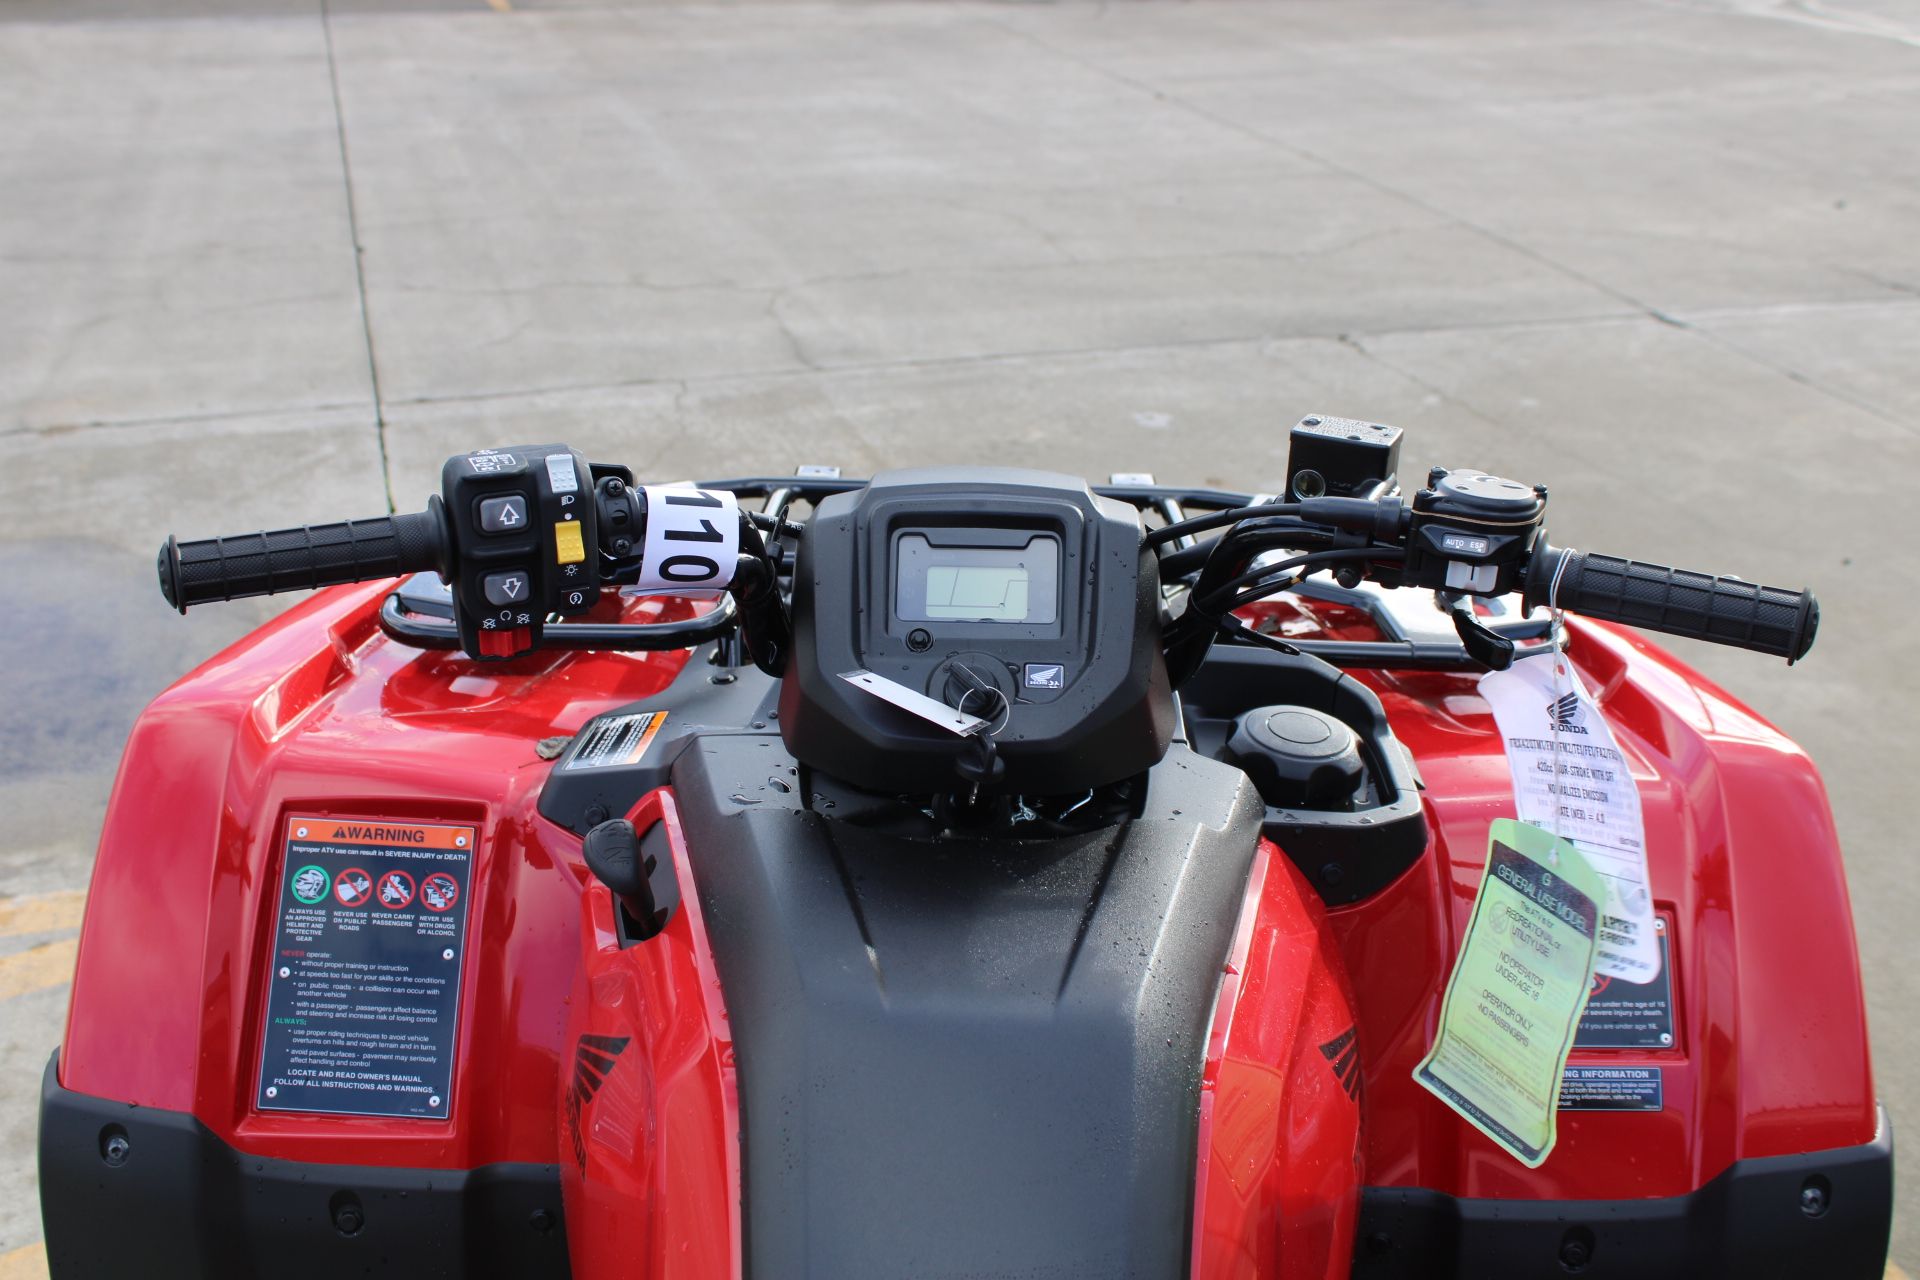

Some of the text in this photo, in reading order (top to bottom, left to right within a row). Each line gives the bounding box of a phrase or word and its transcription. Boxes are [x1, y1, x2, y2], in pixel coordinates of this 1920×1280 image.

[659, 491, 723, 582] 110
[348, 826, 424, 842] WARNING
[292, 845, 320, 854] Improper
[1542, 873, 1552, 886] G
[1498, 865, 1537, 898] GENERAL
[1538, 890, 1558, 911] USE
[1557, 902, 1588, 932] MODEL
[1506, 906, 1553, 946] RECREATIONAL
[1512, 925, 1550, 958] UTILITY USE
[1496, 963, 1532, 995] UNDER AGE
[1499, 951, 1544, 990] NO OPERATOR
[396, 1015, 414, 1023] losing
[1482, 989, 1533, 1031] OPERATOR ONLY
[1488, 1010, 1528, 1047] PASSENGERS
[308, 1058, 334, 1066] handling
[409, 1056, 437, 1064] seriously
[1582, 1070, 1649, 1078] INFORMATION
[322, 1081, 375, 1090] INSTRUCTIONS
[394, 1084, 435, 1093] WARNINGS.
